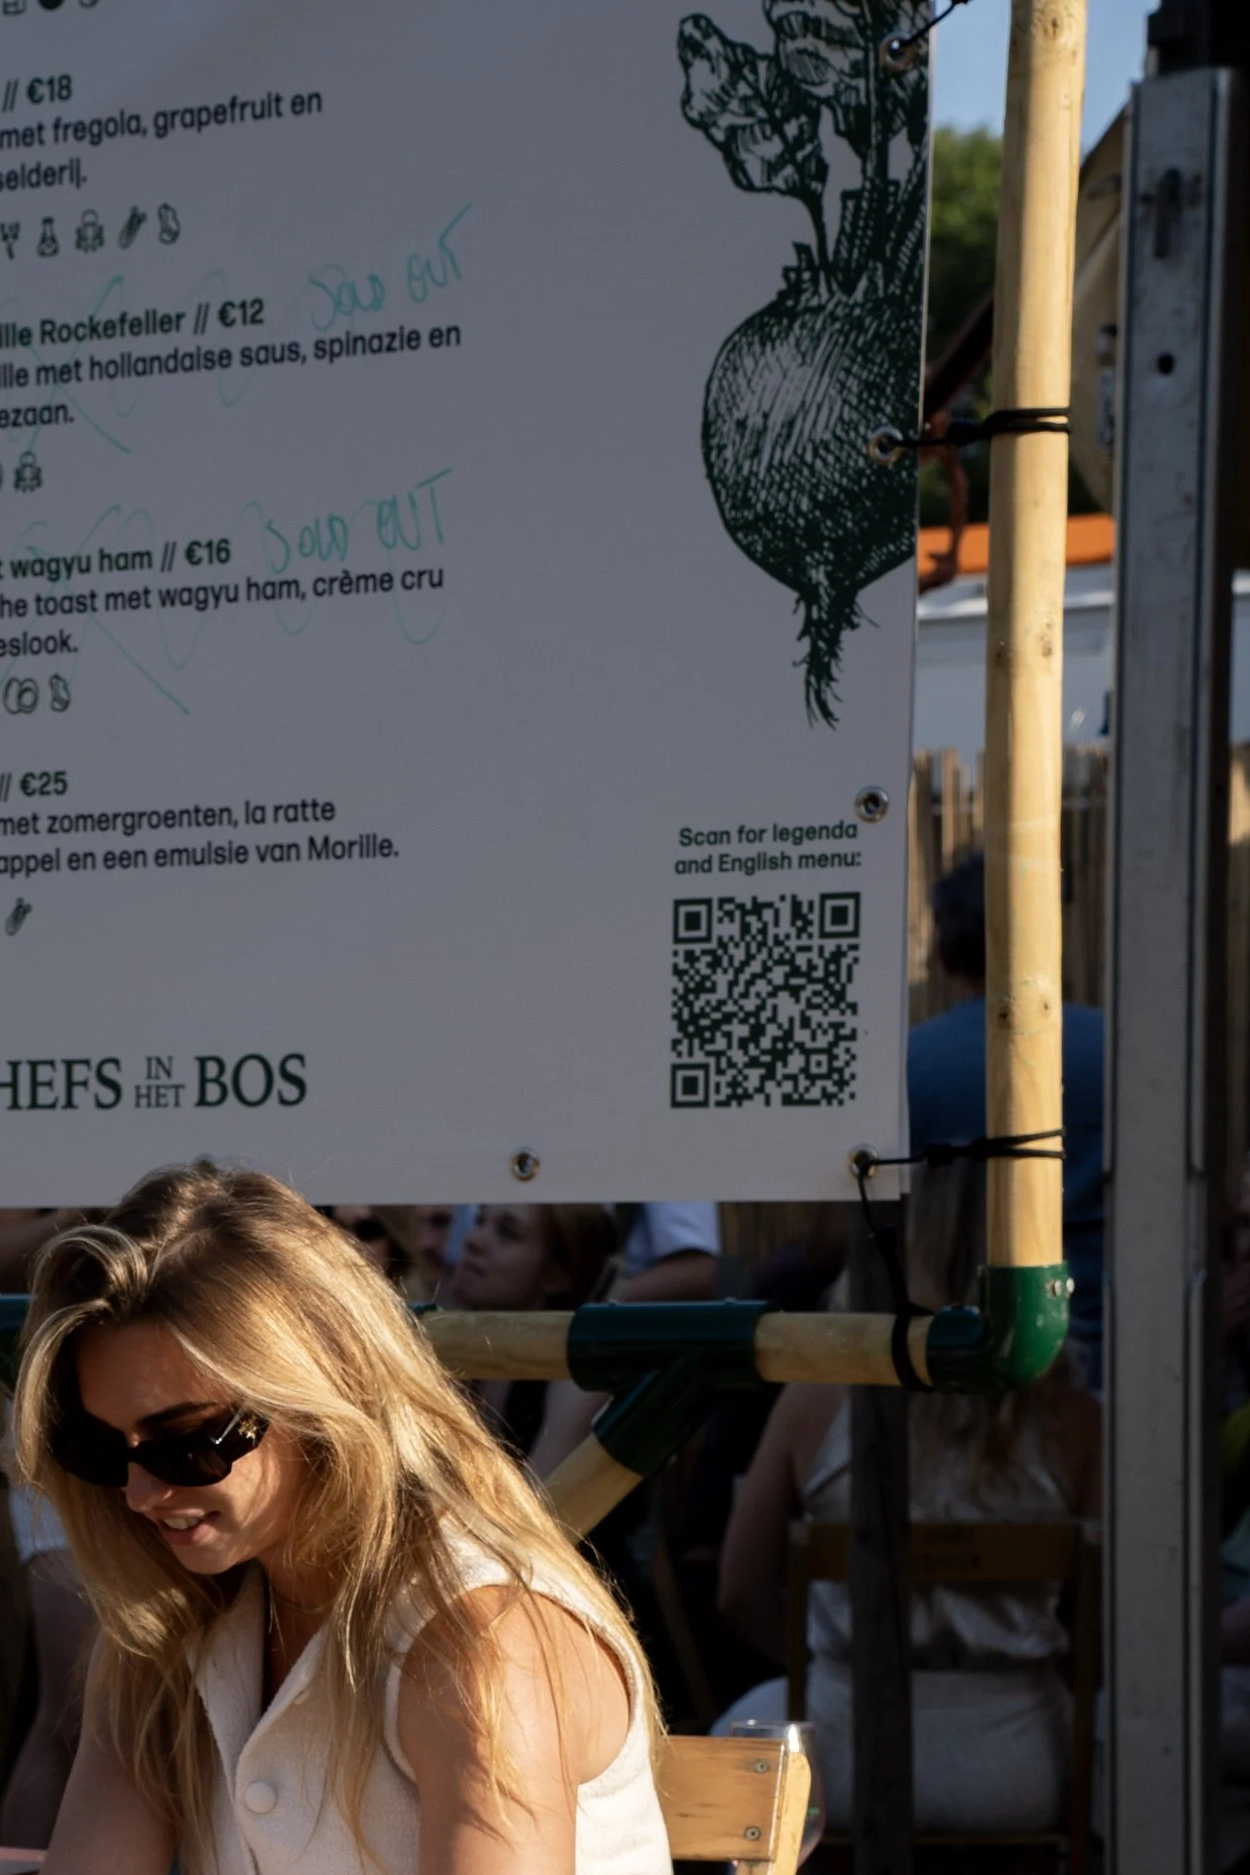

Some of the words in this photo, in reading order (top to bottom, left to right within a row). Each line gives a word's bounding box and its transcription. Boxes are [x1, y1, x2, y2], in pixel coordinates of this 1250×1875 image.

[2, 81, 19, 112] //
[26, 73, 73, 105] €18
[52, 109, 148, 147] fregola,
[153, 92, 283, 139] grapefruit
[290, 92, 322, 116] en
[39, 309, 186, 345] Rockefeller
[193, 303, 210, 335] //
[217, 297, 264, 328] €12
[35, 359, 83, 385] met
[89, 346, 233, 381] hollandaise
[240, 341, 307, 367] saus,
[313, 325, 422, 364] spinazie
[428, 325, 461, 349] en
[9, 555, 92, 583] wagyu
[98, 547, 153, 573] ham
[160, 542, 177, 572] //
[184, 538, 231, 567] €16
[34, 589, 98, 616] toast
[105, 586, 152, 612] met
[157, 583, 239, 612] wagyu
[246, 577, 306, 601] ham,
[312, 569, 394, 597] crème
[400, 568, 444, 591] cru
[19, 770, 68, 798] €25
[46, 805, 239, 837] zomergroenten,
[244, 800, 266, 825] la
[273, 798, 336, 824] ratte
[679, 827, 732, 847] Scan
[736, 824, 767, 844] for
[772, 819, 858, 846] legenda
[66, 851, 97, 872] en
[102, 849, 148, 870] een
[153, 840, 250, 868] emulsie
[255, 842, 301, 864] van
[308, 833, 399, 861] Morille.
[674, 854, 713, 875] and
[718, 851, 793, 876] English
[797, 851, 862, 869] menu:
[146, 1056, 173, 1080] IN
[194, 1052, 307, 1109] BOS
[135, 1084, 186, 1109] HET
